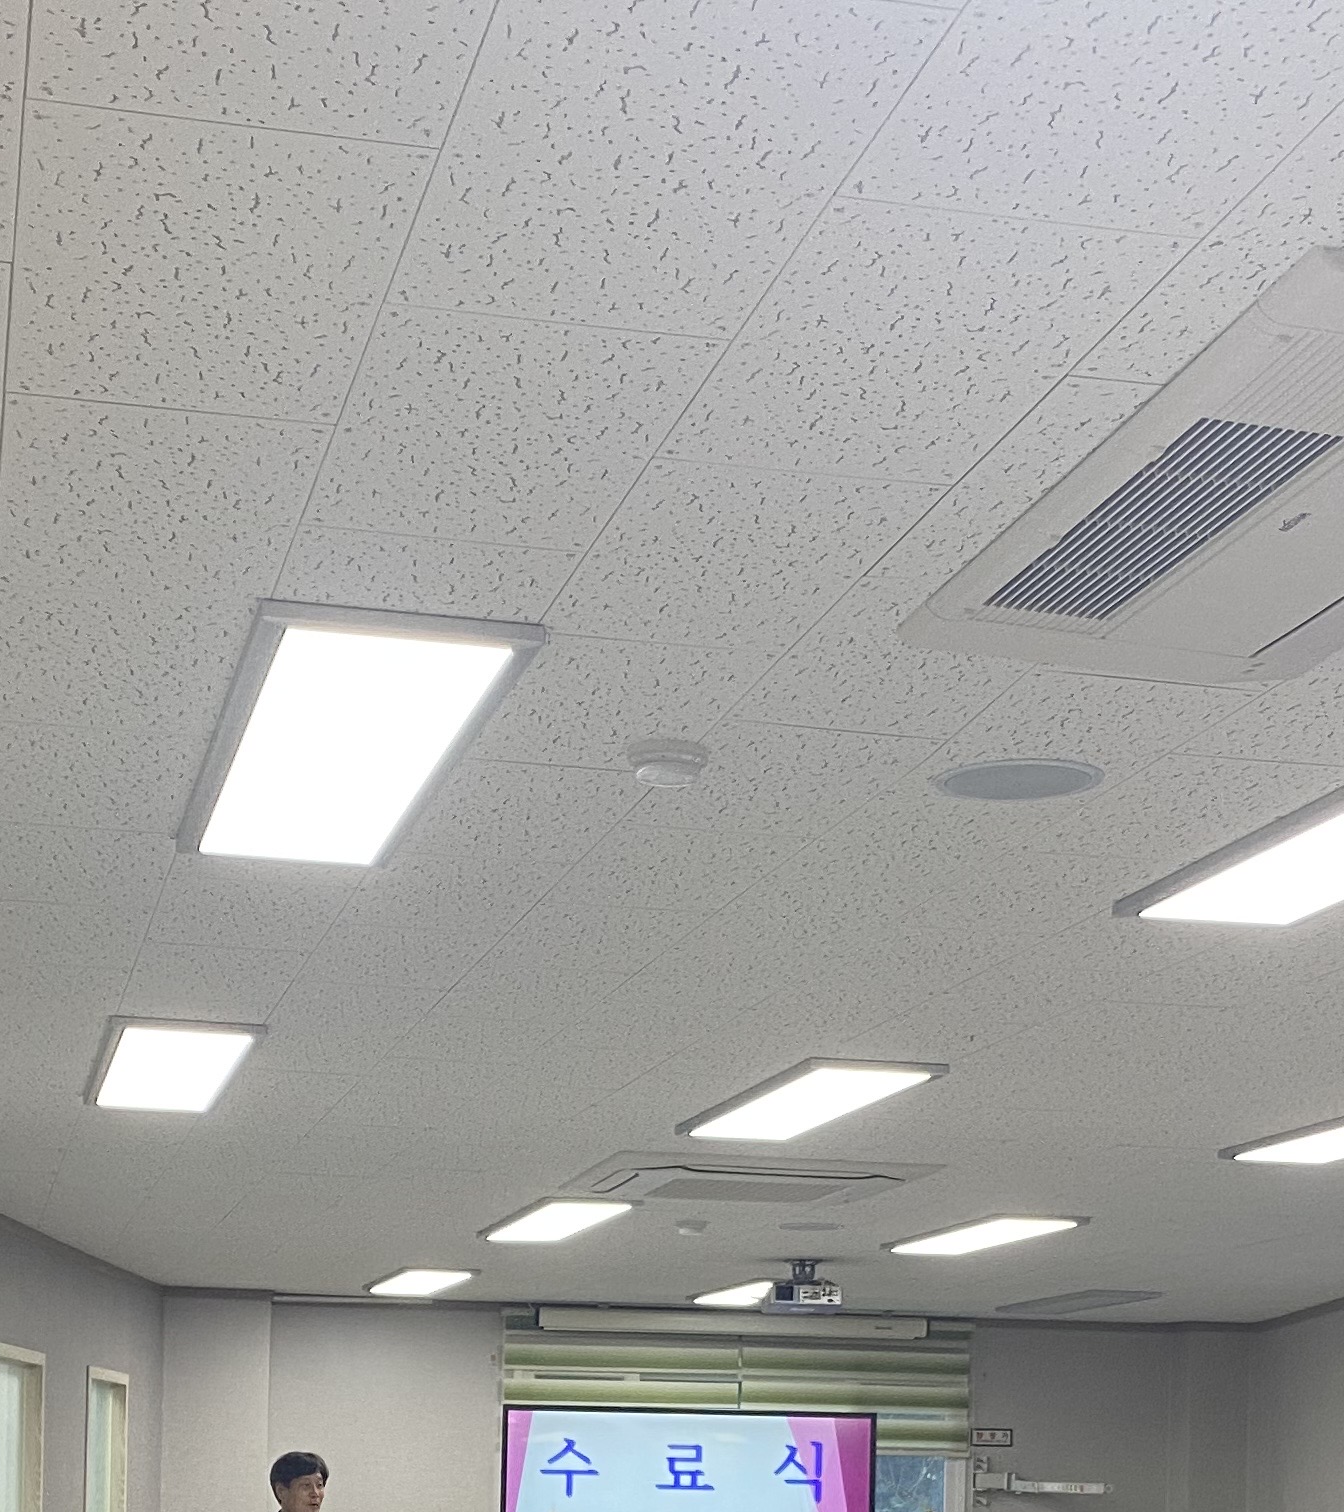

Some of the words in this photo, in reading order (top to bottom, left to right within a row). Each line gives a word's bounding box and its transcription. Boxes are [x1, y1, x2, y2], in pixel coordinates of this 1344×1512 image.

[539, 1437, 600, 1498] 수
[655, 1443, 716, 1491] 료
[773, 1440, 824, 1504] 식
